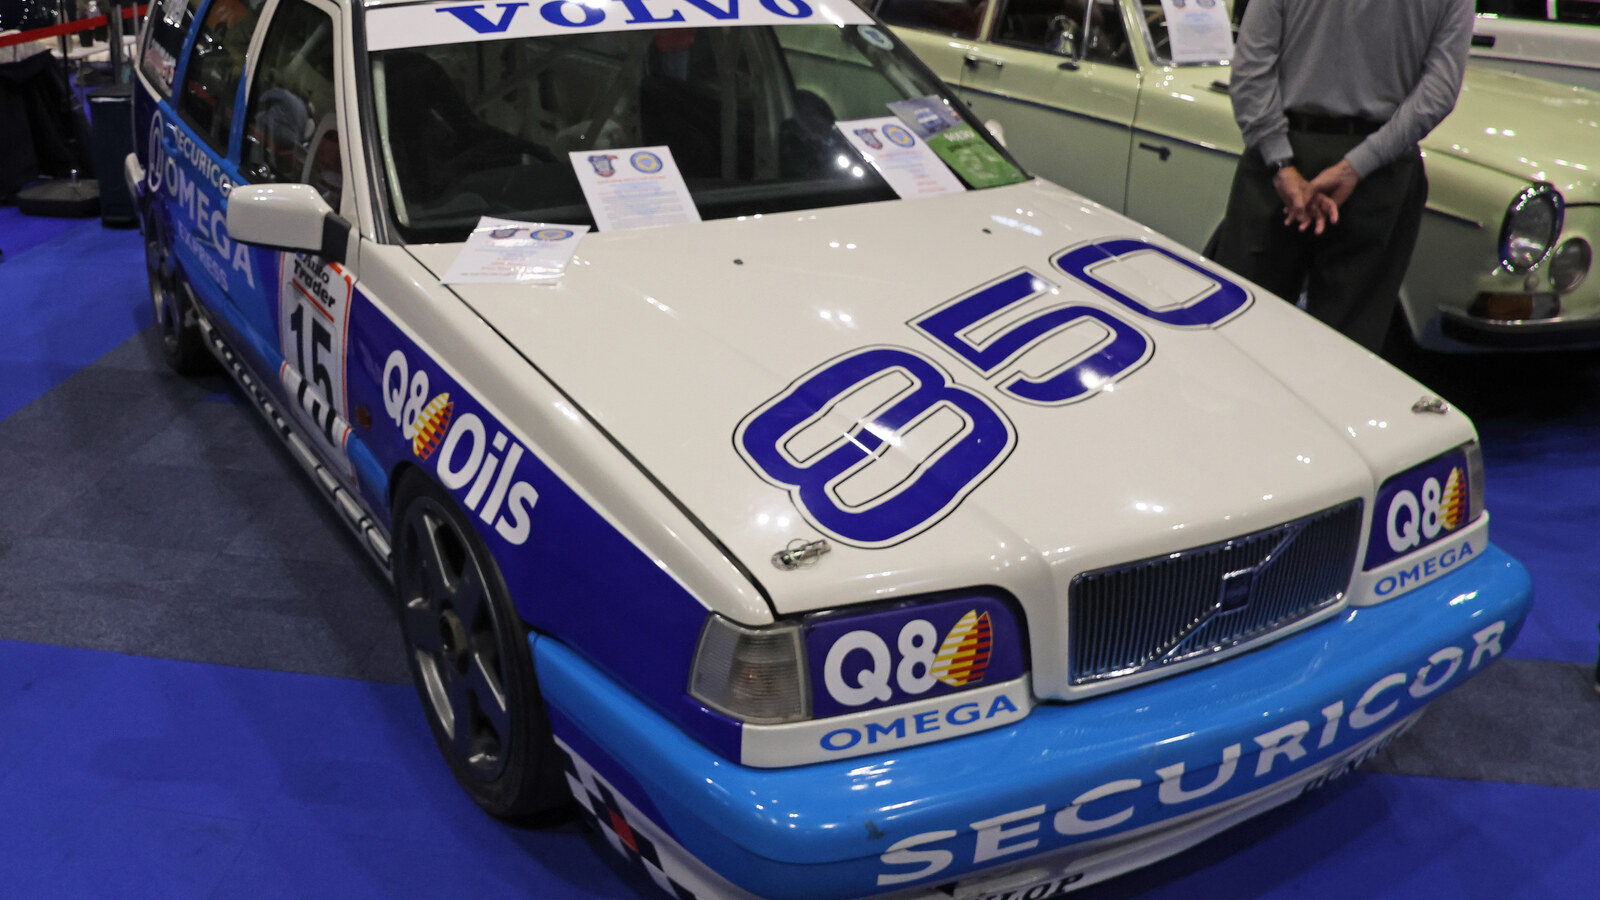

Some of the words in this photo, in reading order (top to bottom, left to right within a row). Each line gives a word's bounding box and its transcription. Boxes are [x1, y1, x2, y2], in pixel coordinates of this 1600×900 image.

[435, 0, 813, 34] VOLVO
[173, 125, 238, 198] SECURICO
[165, 157, 255, 289] OMEGA
[294, 259, 336, 308] Trader
[290, 302, 338, 447] 15
[732, 236, 1255, 549] 850
[383, 350, 430, 440] Q8
[437, 413, 540, 545] Oils
[1387, 477, 1443, 553] Q8
[1374, 541, 1474, 596] OMEGA
[824, 619, 939, 706] Q8
[819, 694, 1018, 751] OMEGA
[876, 620, 1507, 886] SECURICOR
